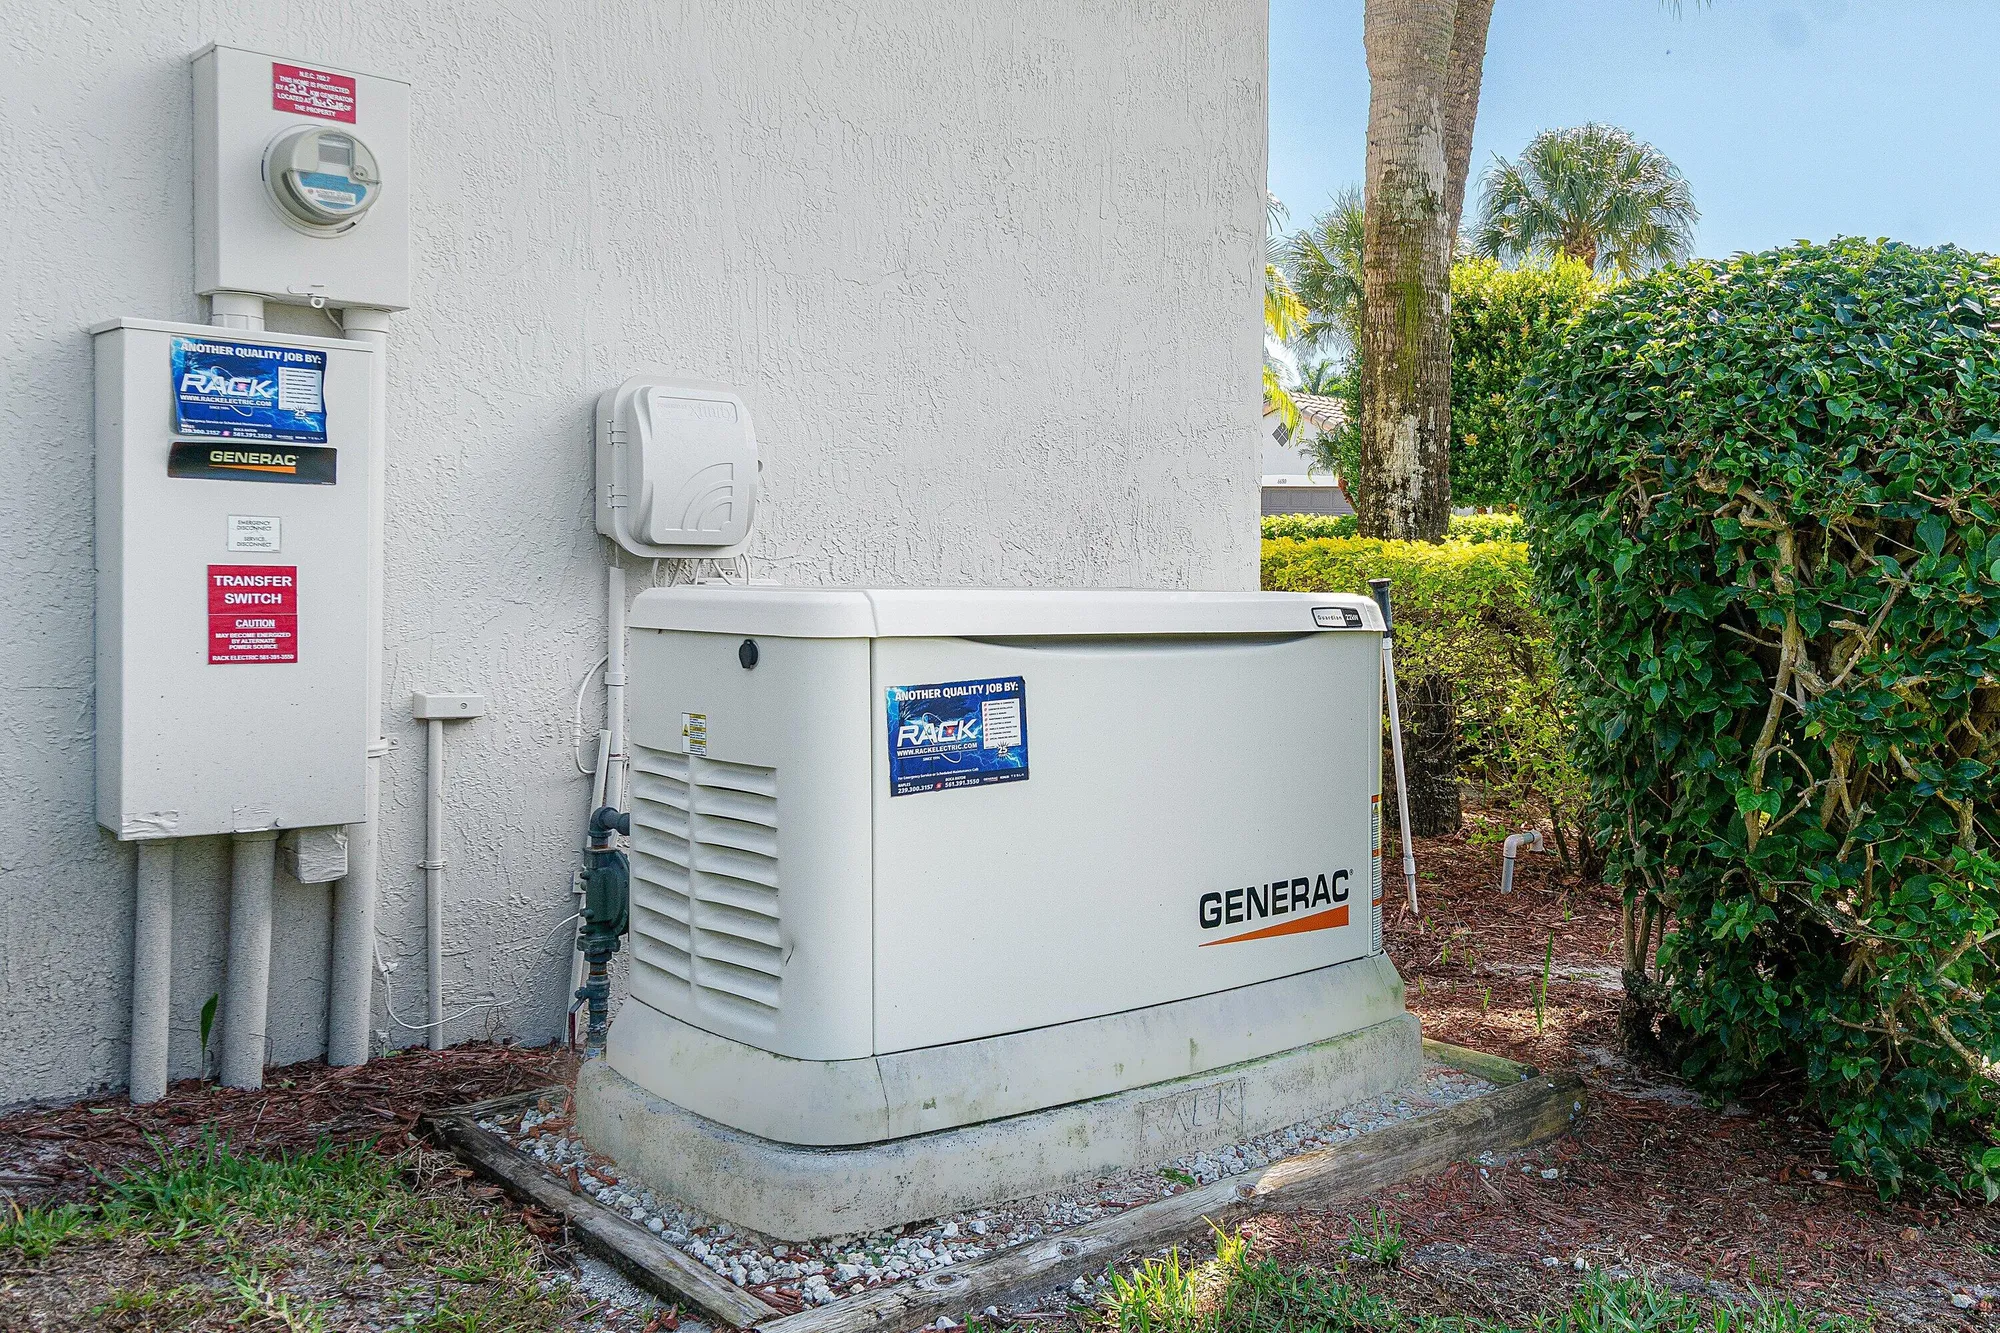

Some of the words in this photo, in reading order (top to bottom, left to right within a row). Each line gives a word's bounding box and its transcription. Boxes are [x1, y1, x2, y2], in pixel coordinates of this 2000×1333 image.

[293, 78, 309, 87] HOME
[317, 83, 350, 94] PROTECTED
[277, 93, 303, 102] LOCATED
[320, 92, 354, 103] GENERATOR
[306, 106, 336, 116] PROPERTY
[181, 343, 234, 356] ANOTHER
[235, 348, 282, 361] QUALITY
[284, 352, 303, 362] JOB
[305, 354, 322, 364] BY:
[180, 373, 272, 398] RACK
[180, 394, 272, 407] WWW.RACKELECTRIC.COM
[210, 450, 296, 466] GENERAC
[213, 575, 292, 587] TRANSFER
[225, 593, 282, 604] SWITCH
[235, 619, 275, 628] CAUTION
[895, 688, 941, 701] ANOTHER
[943, 685, 984, 697] QUALITY
[985, 683, 1002, 694] JOB
[1004, 682, 1019, 692] BY:
[897, 719, 977, 747] RACK
[897, 742, 977, 757] WWW.RACKELECTRIC.COM
[898, 784, 933, 794] 239.300.3157
[945, 779, 980, 788] 561.391.3550
[1200, 869, 1349, 929] GENERAC
